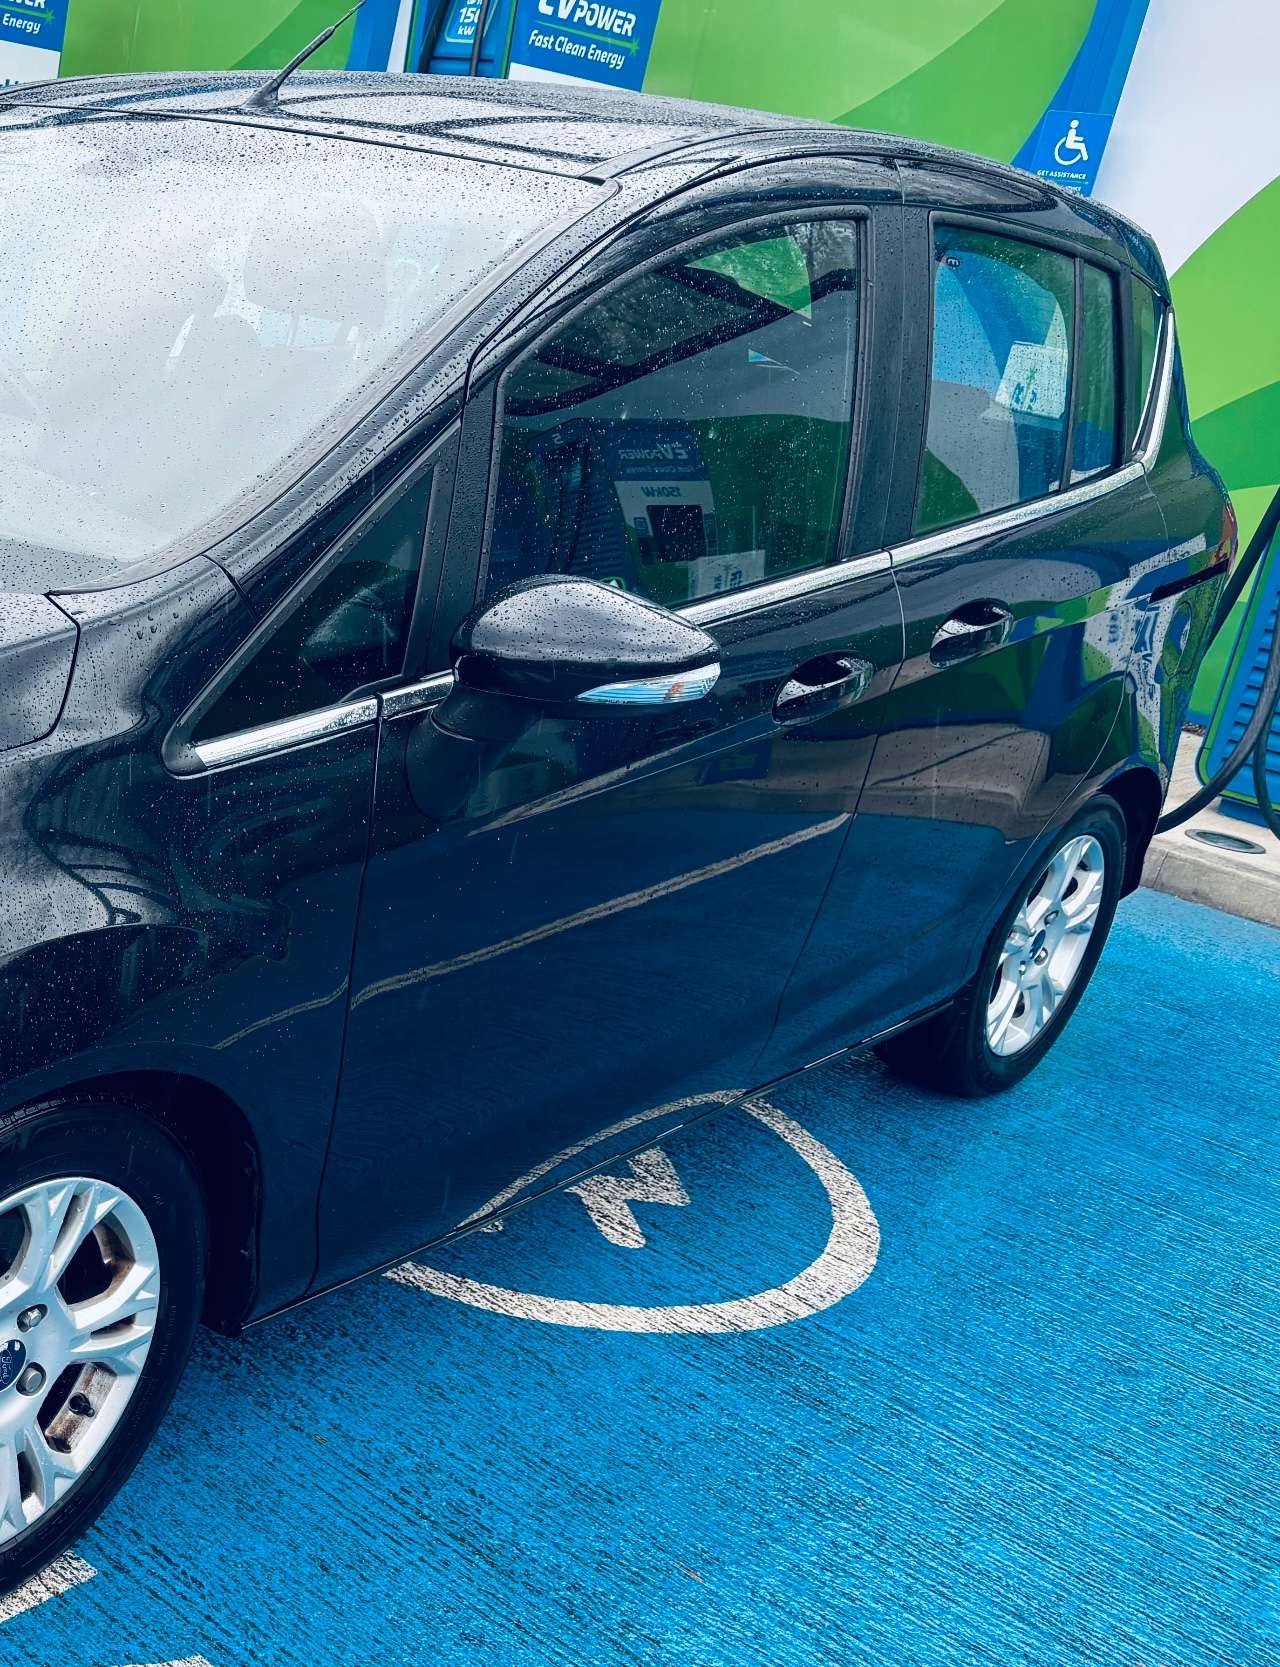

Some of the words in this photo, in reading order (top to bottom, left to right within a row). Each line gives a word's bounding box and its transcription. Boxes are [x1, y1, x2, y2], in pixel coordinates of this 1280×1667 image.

[2, 13, 41, 34] Energy
[457, 25, 475, 36] kW
[528, 30, 554, 50] Fast
[555, 36, 590, 57] Clean
[588, 44, 626, 70] Energy
[1036, 169, 1049, 177] GET
[1049, 171, 1087, 180] ASSISTANCE
